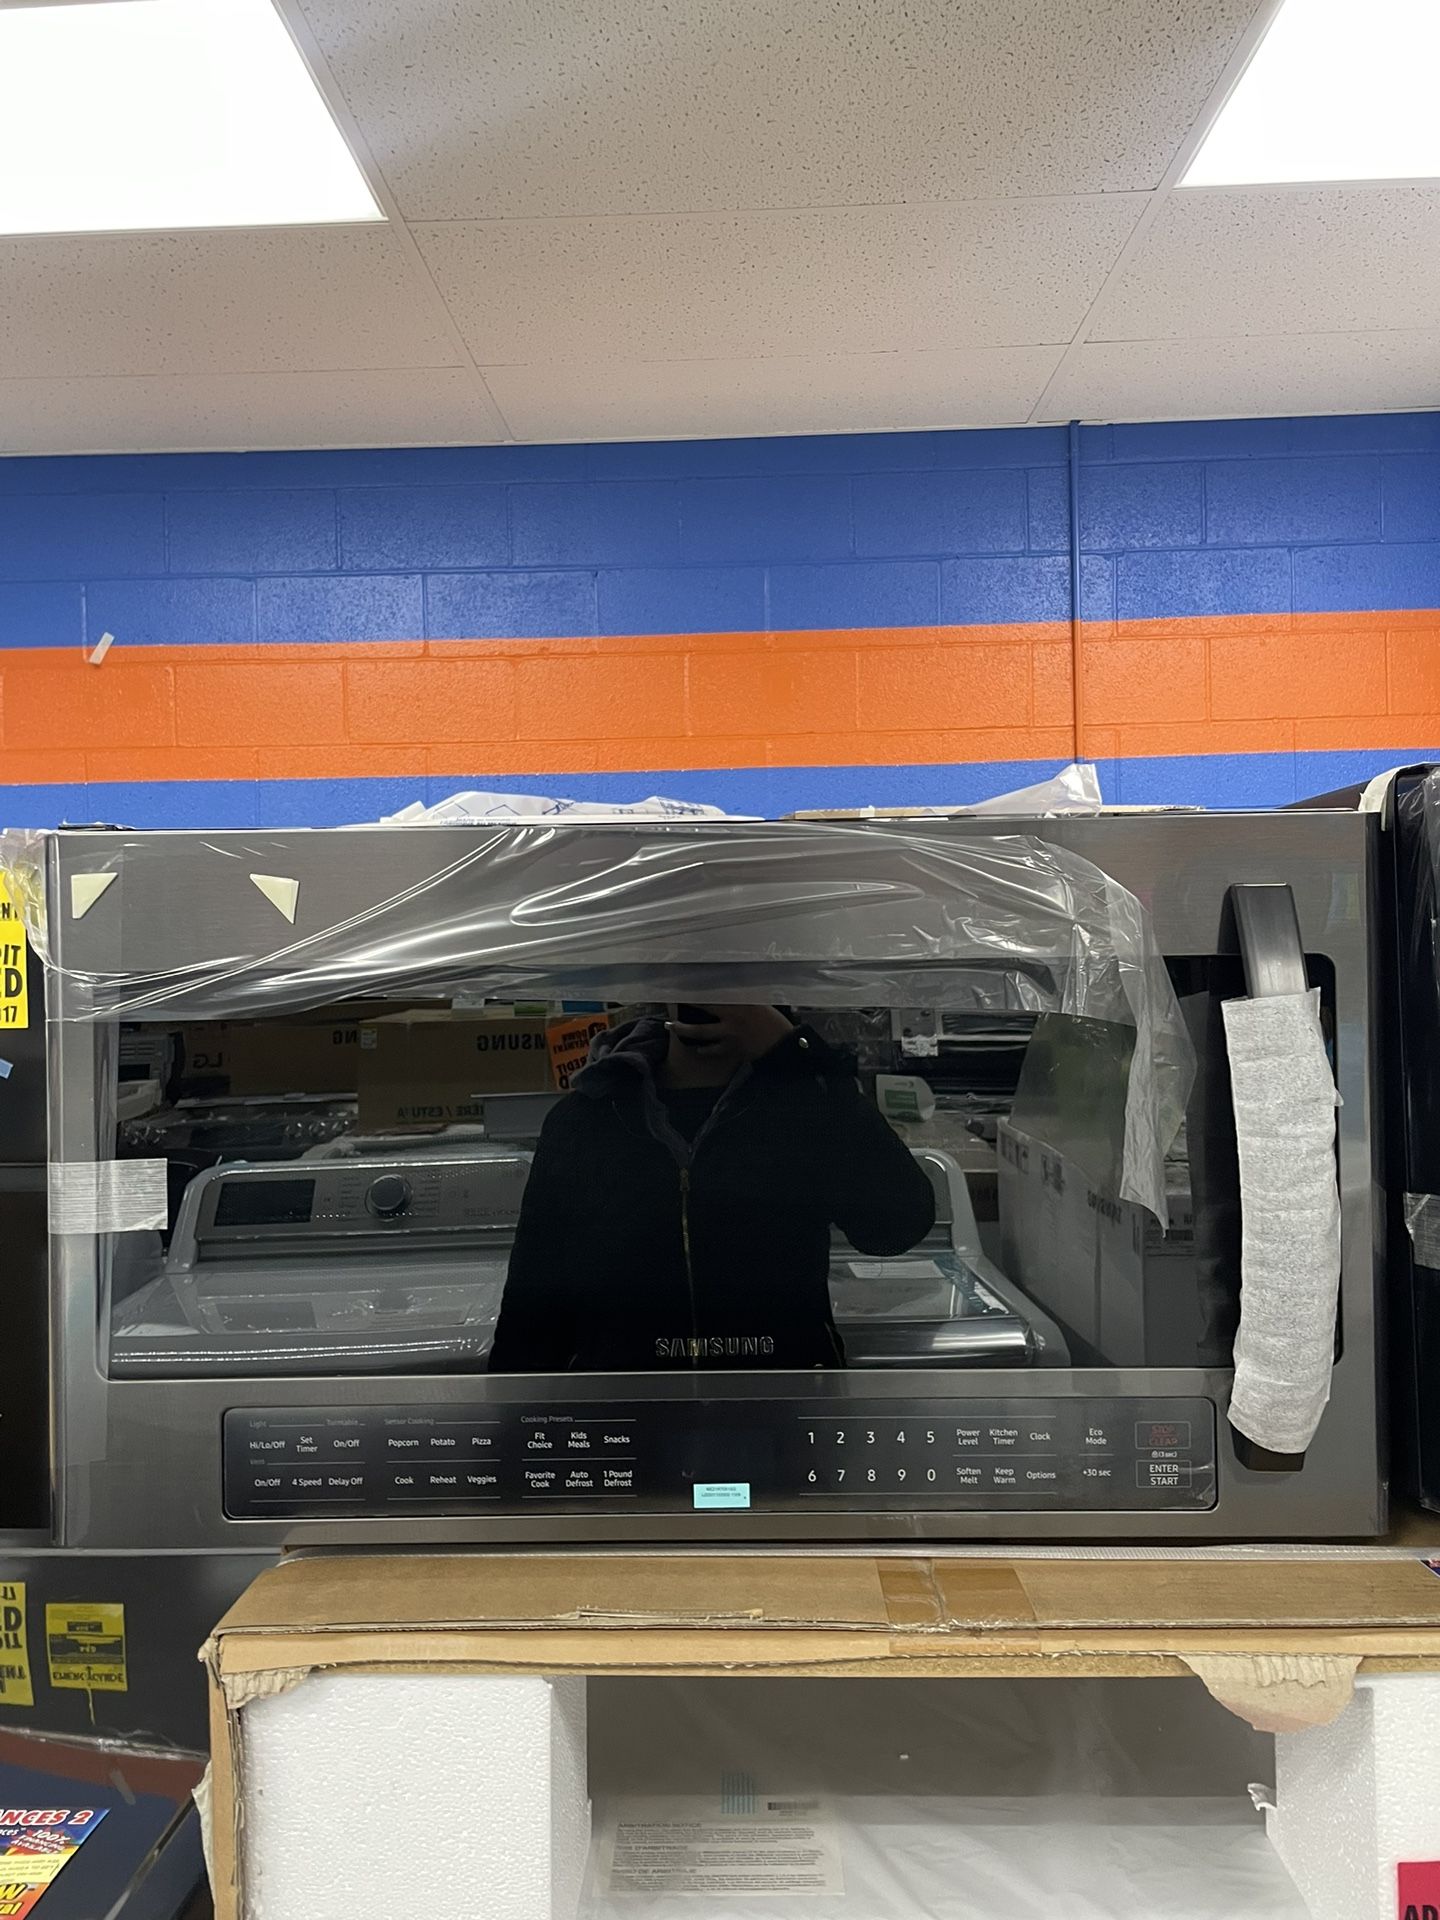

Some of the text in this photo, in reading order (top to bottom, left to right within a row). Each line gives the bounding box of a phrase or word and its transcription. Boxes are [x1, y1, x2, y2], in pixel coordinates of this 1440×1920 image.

[0, 944, 21, 966] IT
[0, 967, 23, 998] D
[655, 1336, 774, 1357] SAMSUNG
[521, 1416, 548, 1424] Cooking
[534, 1432, 546, 1440] Fit
[570, 1431, 588, 1440] Kids
[989, 1428, 1018, 1436] Kitchen
[1029, 1432, 1051, 1440] Clock
[1089, 1428, 1103, 1436] Eco
[300, 1436, 313, 1444] Set
[471, 1437, 492, 1445] Pizza
[603, 1435, 631, 1444] Snacks
[807, 1431, 935, 1444] 1 2 3 4 5
[958, 1437, 978, 1445] Level
[993, 1437, 1015, 1445] Timer
[1085, 1437, 1107, 1445] Mode
[249, 1441, 286, 1449] Hi/Lo/Off
[333, 1440, 360, 1448] On/Off
[388, 1438, 419, 1448] Popcorn
[430, 1438, 456, 1446] Potato
[527, 1441, 553, 1449] Choice
[567, 1440, 591, 1448] Meals
[296, 1445, 318, 1453] Timer
[956, 1467, 982, 1475] Soften
[994, 1467, 1015, 1476] Keep
[1149, 1464, 1179, 1473] ENTER
[525, 1471, 556, 1479] Favorite
[569, 1471, 589, 1479] Auto
[602, 1470, 633, 1478] 1 Pound
[807, 1469, 936, 1482] 6 7 8 9 0
[1026, 1471, 1056, 1480] Options
[1098, 1469, 1112, 1477] sec
[254, 1478, 281, 1487] On/Off
[299, 1478, 323, 1487] Speed
[328, 1477, 363, 1486] Delay Off
[394, 1476, 415, 1485] Cook
[429, 1475, 457, 1484] Reheat
[466, 1475, 497, 1485] Veggies
[565, 1479, 594, 1487] Defrost
[604, 1479, 632, 1487] Defrost
[960, 1476, 978, 1484] Melt
[993, 1476, 1016, 1484] Warm
[1150, 1477, 1179, 1486] START
[530, 1480, 550, 1488] Cook
[0, 1809, 94, 1826] NCES 2
